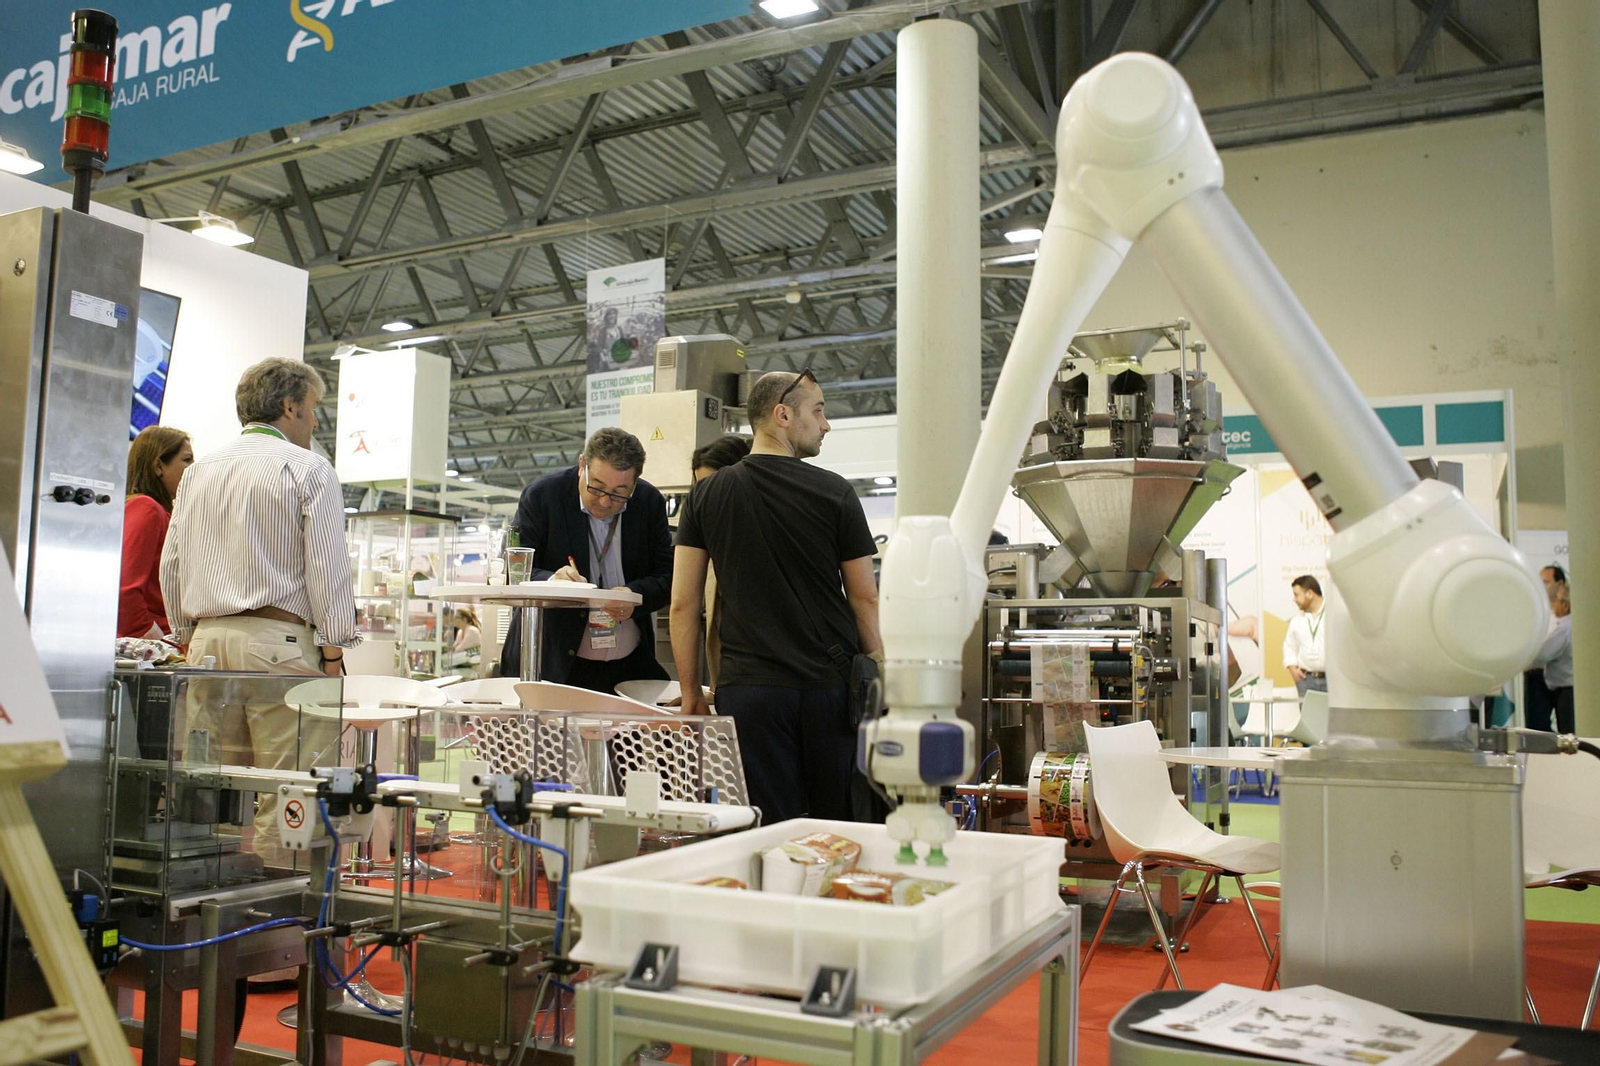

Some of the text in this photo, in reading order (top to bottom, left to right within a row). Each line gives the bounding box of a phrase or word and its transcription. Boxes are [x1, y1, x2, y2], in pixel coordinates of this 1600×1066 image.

[0, 2, 232, 122] cajmar
[155, 62, 220, 98] RURAL
[590, 377, 618, 390] NUESTRO
[590, 391, 599, 401] ES
[599, 390, 608, 400] TU
